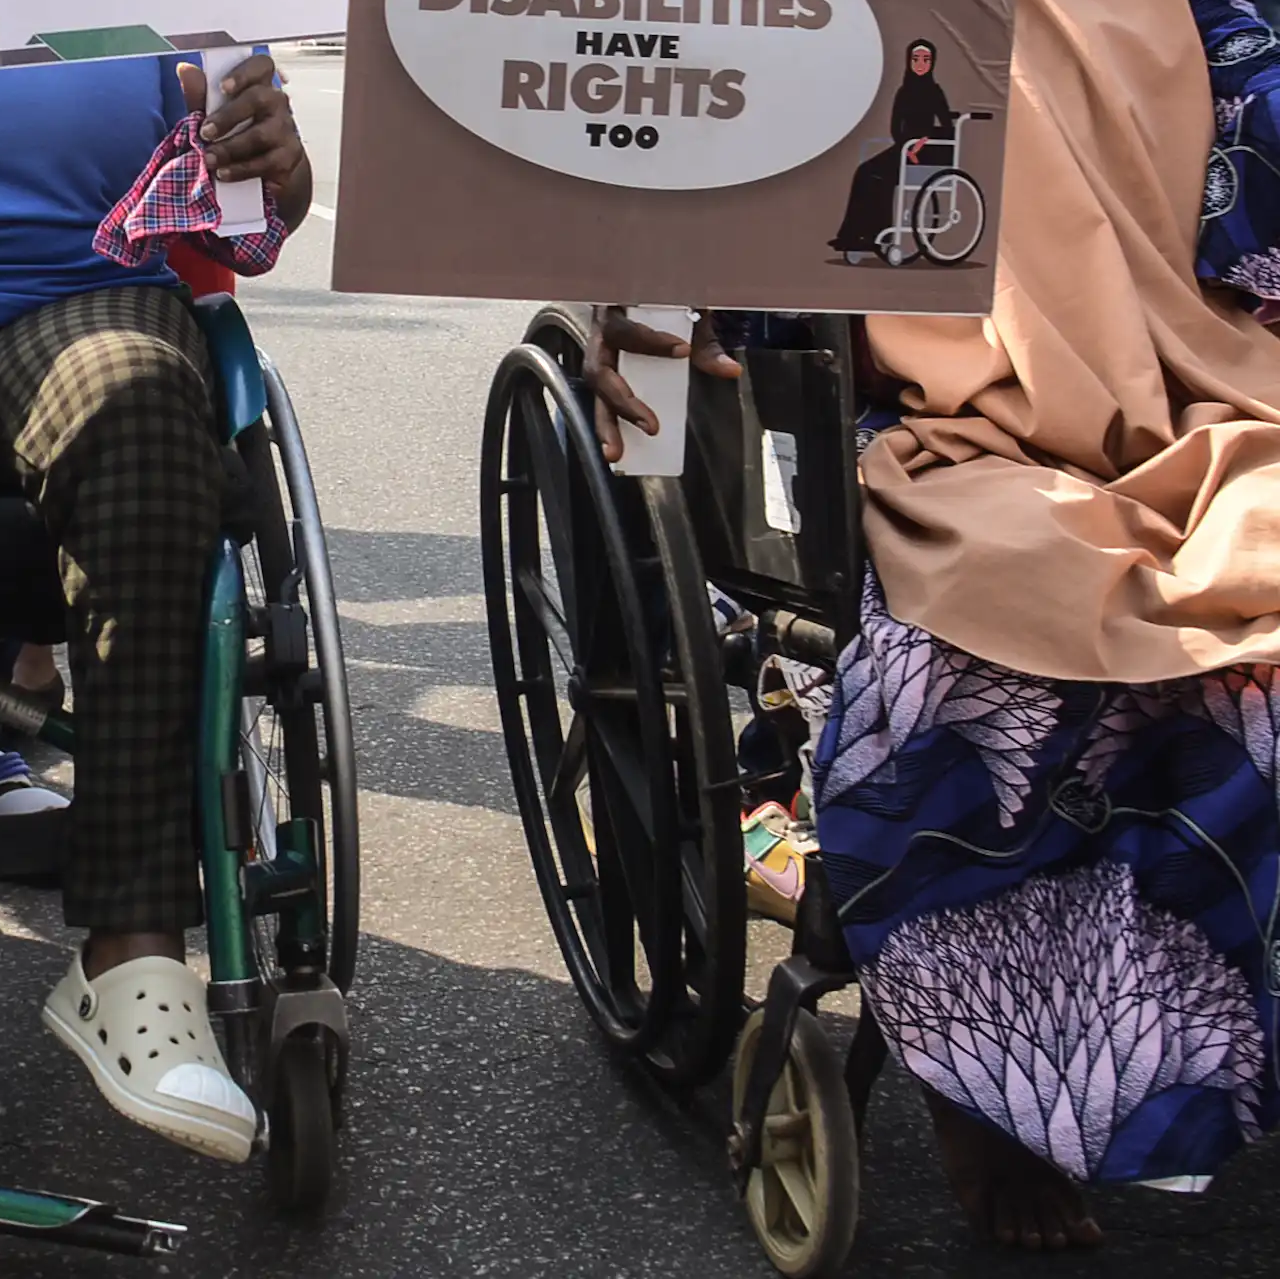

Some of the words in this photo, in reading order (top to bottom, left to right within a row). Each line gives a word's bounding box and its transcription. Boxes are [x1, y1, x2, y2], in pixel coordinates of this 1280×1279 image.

[575, 31, 680, 60] HAVE
[500, 59, 746, 120] RIGHTS
[585, 123, 660, 150] TOO
